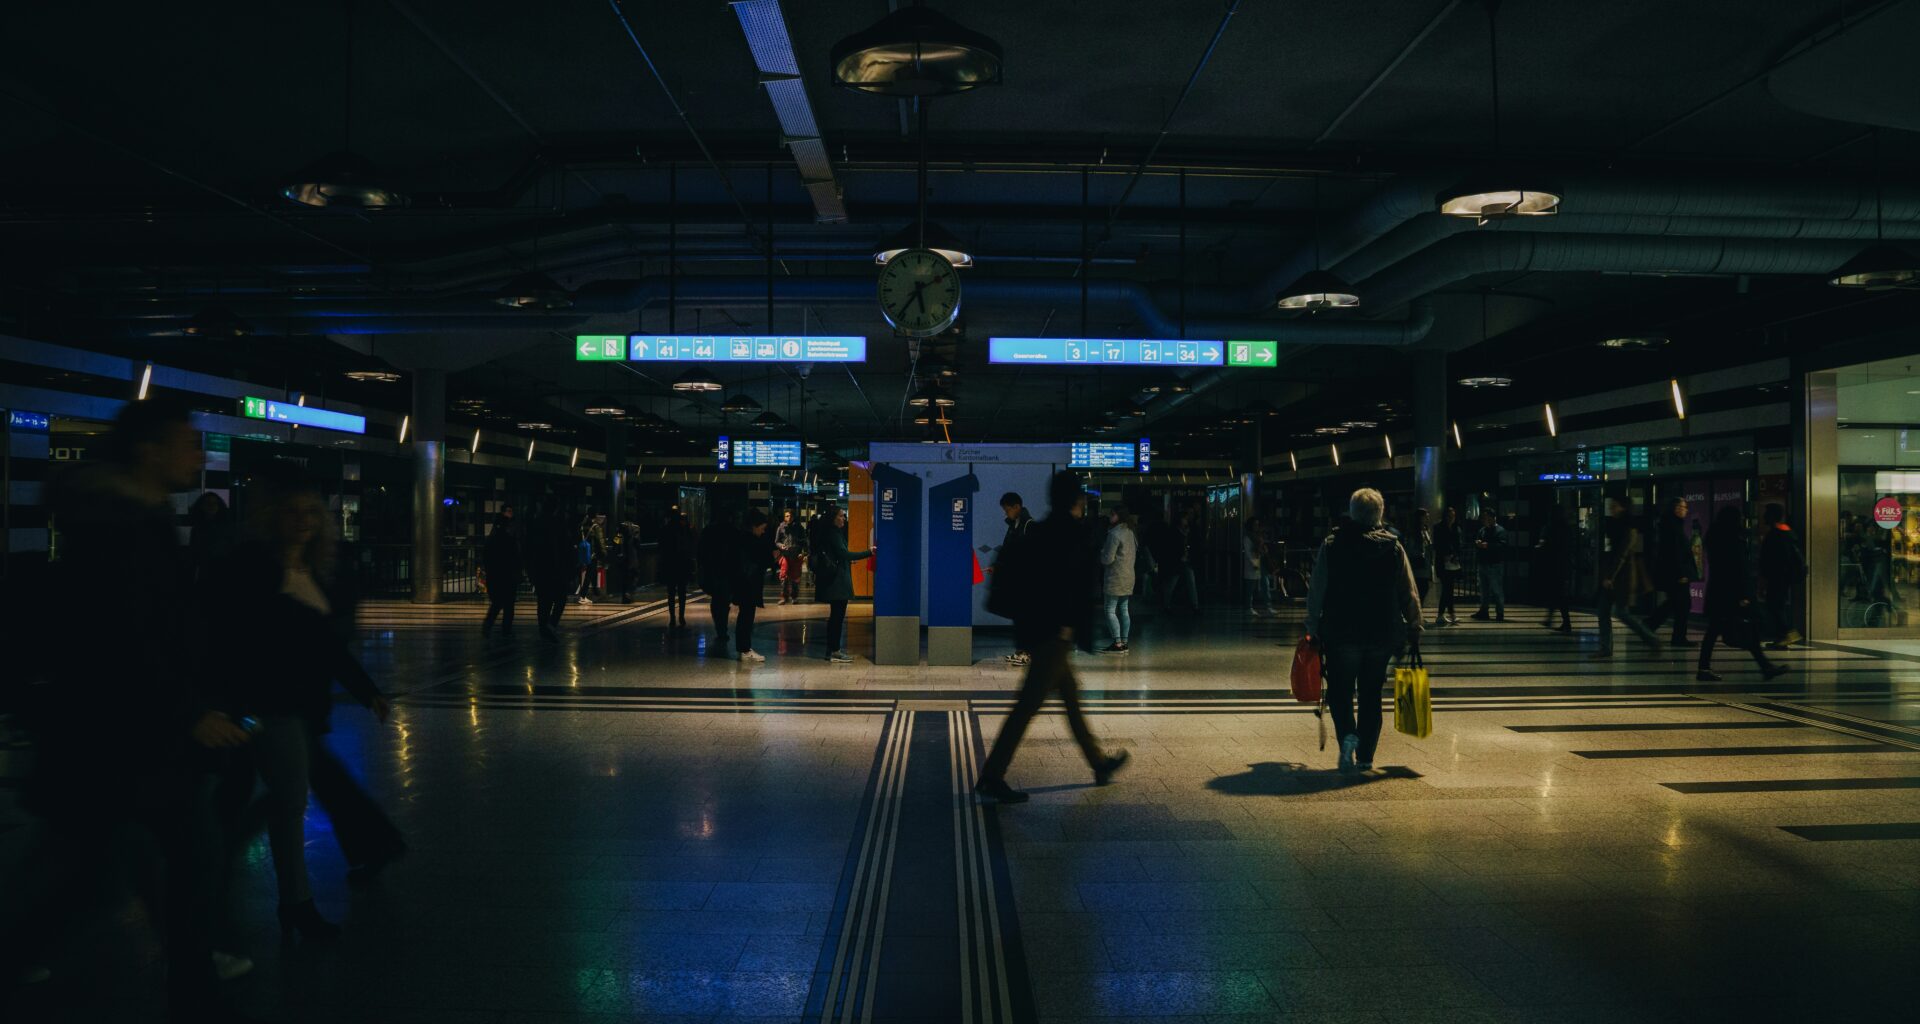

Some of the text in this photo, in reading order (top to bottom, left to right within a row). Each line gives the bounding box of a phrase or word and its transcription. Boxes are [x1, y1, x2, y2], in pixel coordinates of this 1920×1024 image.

[660, 345, 712, 357] 41 44
[1072, 348, 1196, 361] 3 17 21 34
[1669, 449, 1697, 466] BODY
